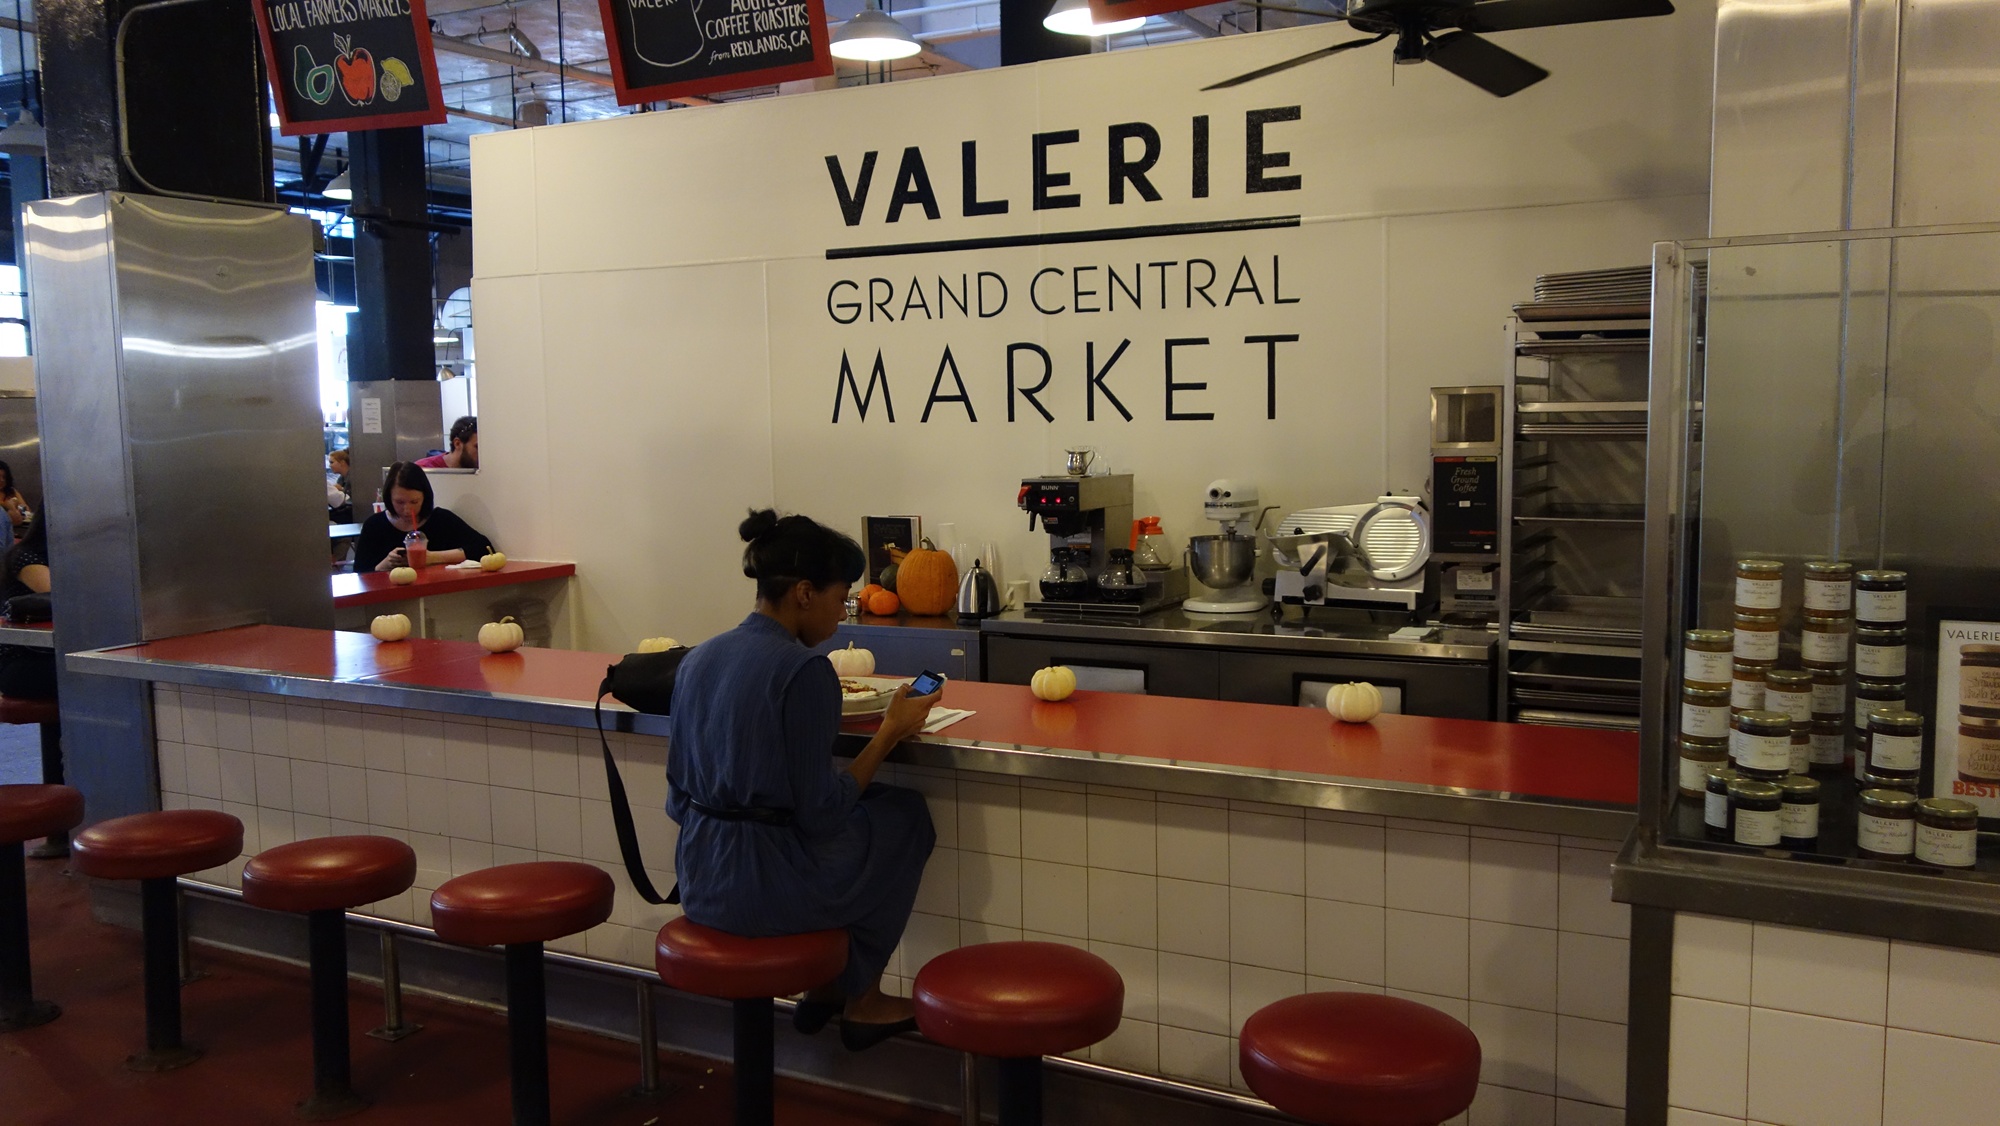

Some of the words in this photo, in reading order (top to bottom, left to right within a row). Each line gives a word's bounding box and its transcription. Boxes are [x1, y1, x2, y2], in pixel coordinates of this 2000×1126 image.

[268, 1, 305, 32] LOCAL
[305, 0, 358, 27] FARMERS
[358, 0, 411, 20] MARKETS
[705, 12, 751, 40] COFFEE
[753, 3, 810, 33] ROASTERS
[708, 50, 731, 65] from
[824, 105, 1302, 227] VALERIE
[827, 272, 1009, 325] GRAND
[1030, 255, 1301, 315] CENTRAL
[832, 334, 1300, 424] MARKET
[1450, 475, 1480, 484] Ground
[1455, 466, 1477, 476] Fresh
[1453, 483, 1478, 493] Coffee
[1946, 629, 2000, 642] VALERIE
[1952, 780, 2000, 798] BEST
